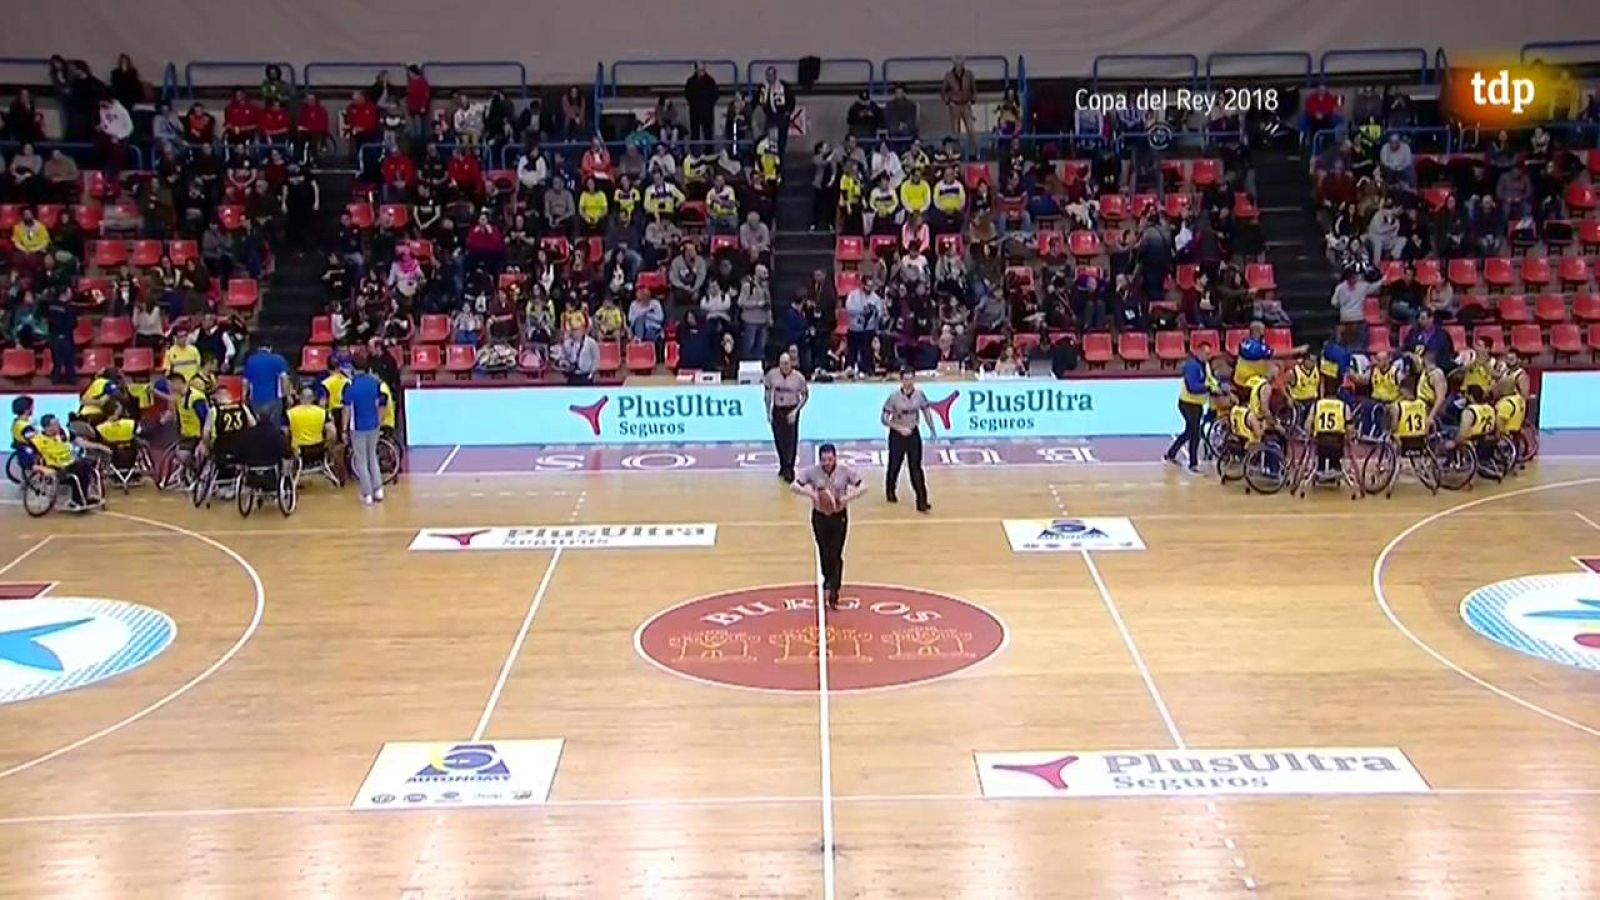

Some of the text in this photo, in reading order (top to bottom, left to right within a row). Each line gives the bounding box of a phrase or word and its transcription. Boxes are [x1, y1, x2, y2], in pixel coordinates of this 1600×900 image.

[617, 395, 743, 418] PlusUltra
[968, 389, 1093, 412] PlusUltra
[223, 410, 243, 431] 23
[618, 420, 685, 437] Seguros
[969, 415, 1035, 432] Seguros
[1319, 412, 1336, 430] 15
[1405, 414, 1423, 431] 13
[700, 596, 942, 626] BURGOS
[1102, 751, 1400, 774] PlusUltra
[1112, 775, 1269, 791] Seguros
